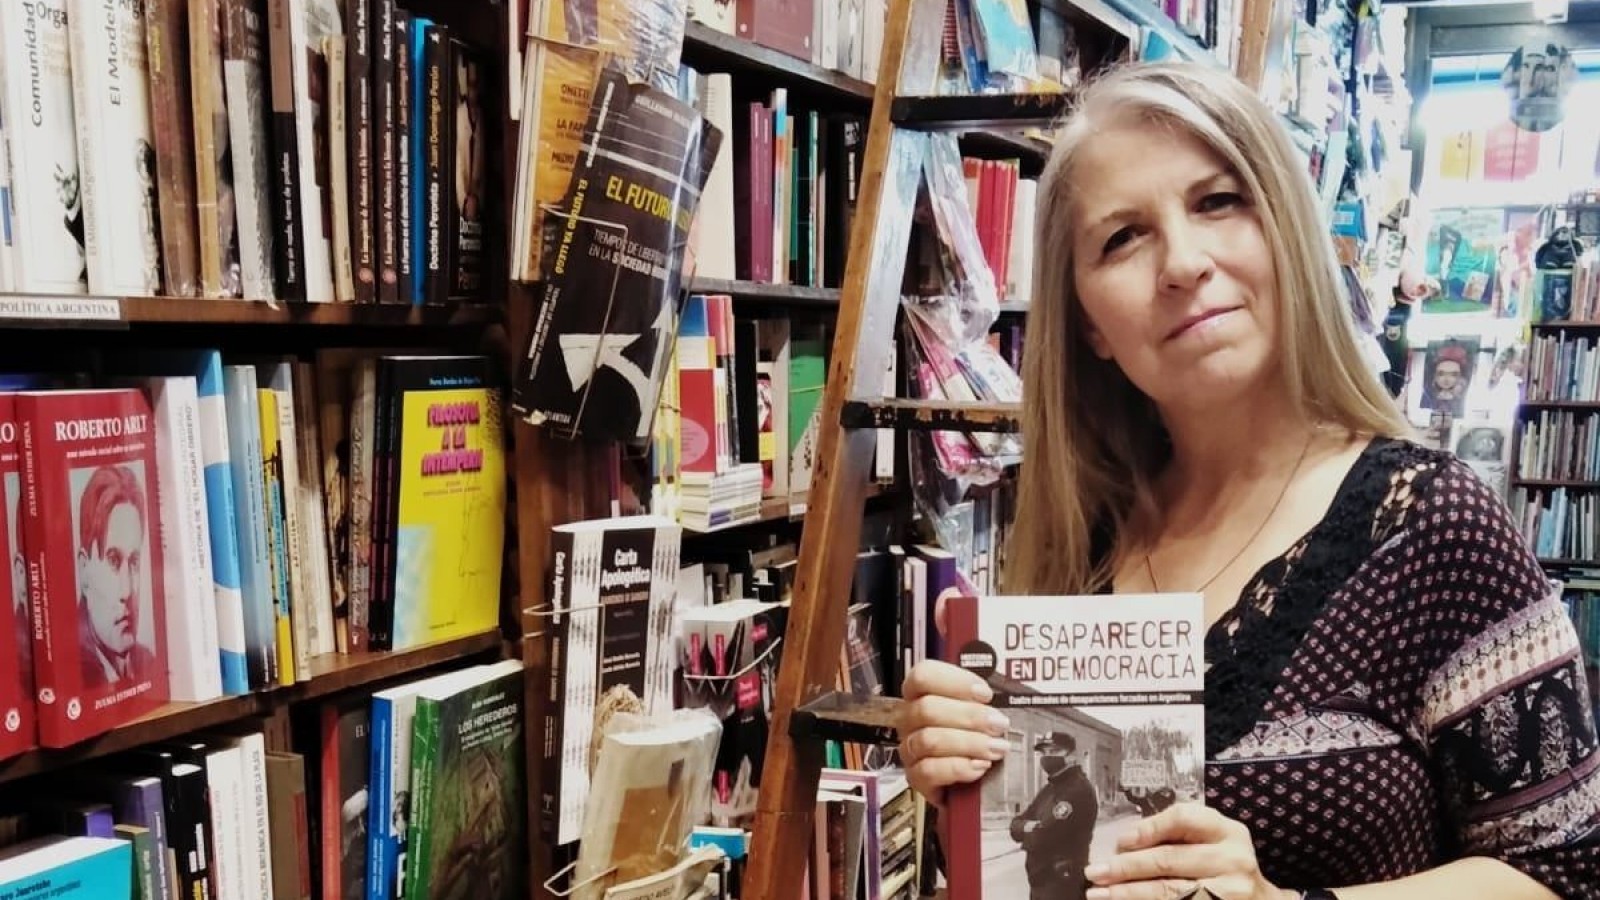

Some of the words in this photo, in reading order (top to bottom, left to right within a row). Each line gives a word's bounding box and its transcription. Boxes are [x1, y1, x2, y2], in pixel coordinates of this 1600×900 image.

[23, 2, 42, 128] Comunidad
[578, 178, 589, 191] EL
[606, 174, 624, 203] EL
[567, 191, 585, 231] FUTURO
[428, 228, 440, 270] Doctrina
[562, 230, 574, 245] YA
[55, 301, 117, 315] ARGENTINA
[55, 416, 123, 443] ROBERTO
[123, 413, 149, 437] ARLT
[615, 548, 639, 568] Carta
[31, 561, 40, 590] ARLT
[33, 590, 44, 640] ROBERTO
[1005, 620, 1192, 651] DESAPARECER
[1012, 660, 1034, 680] EN
[1041, 654, 1197, 682] DEMOCRACIA
[458, 719, 473, 735] LOS
[473, 703, 518, 728] HEREDEROS
